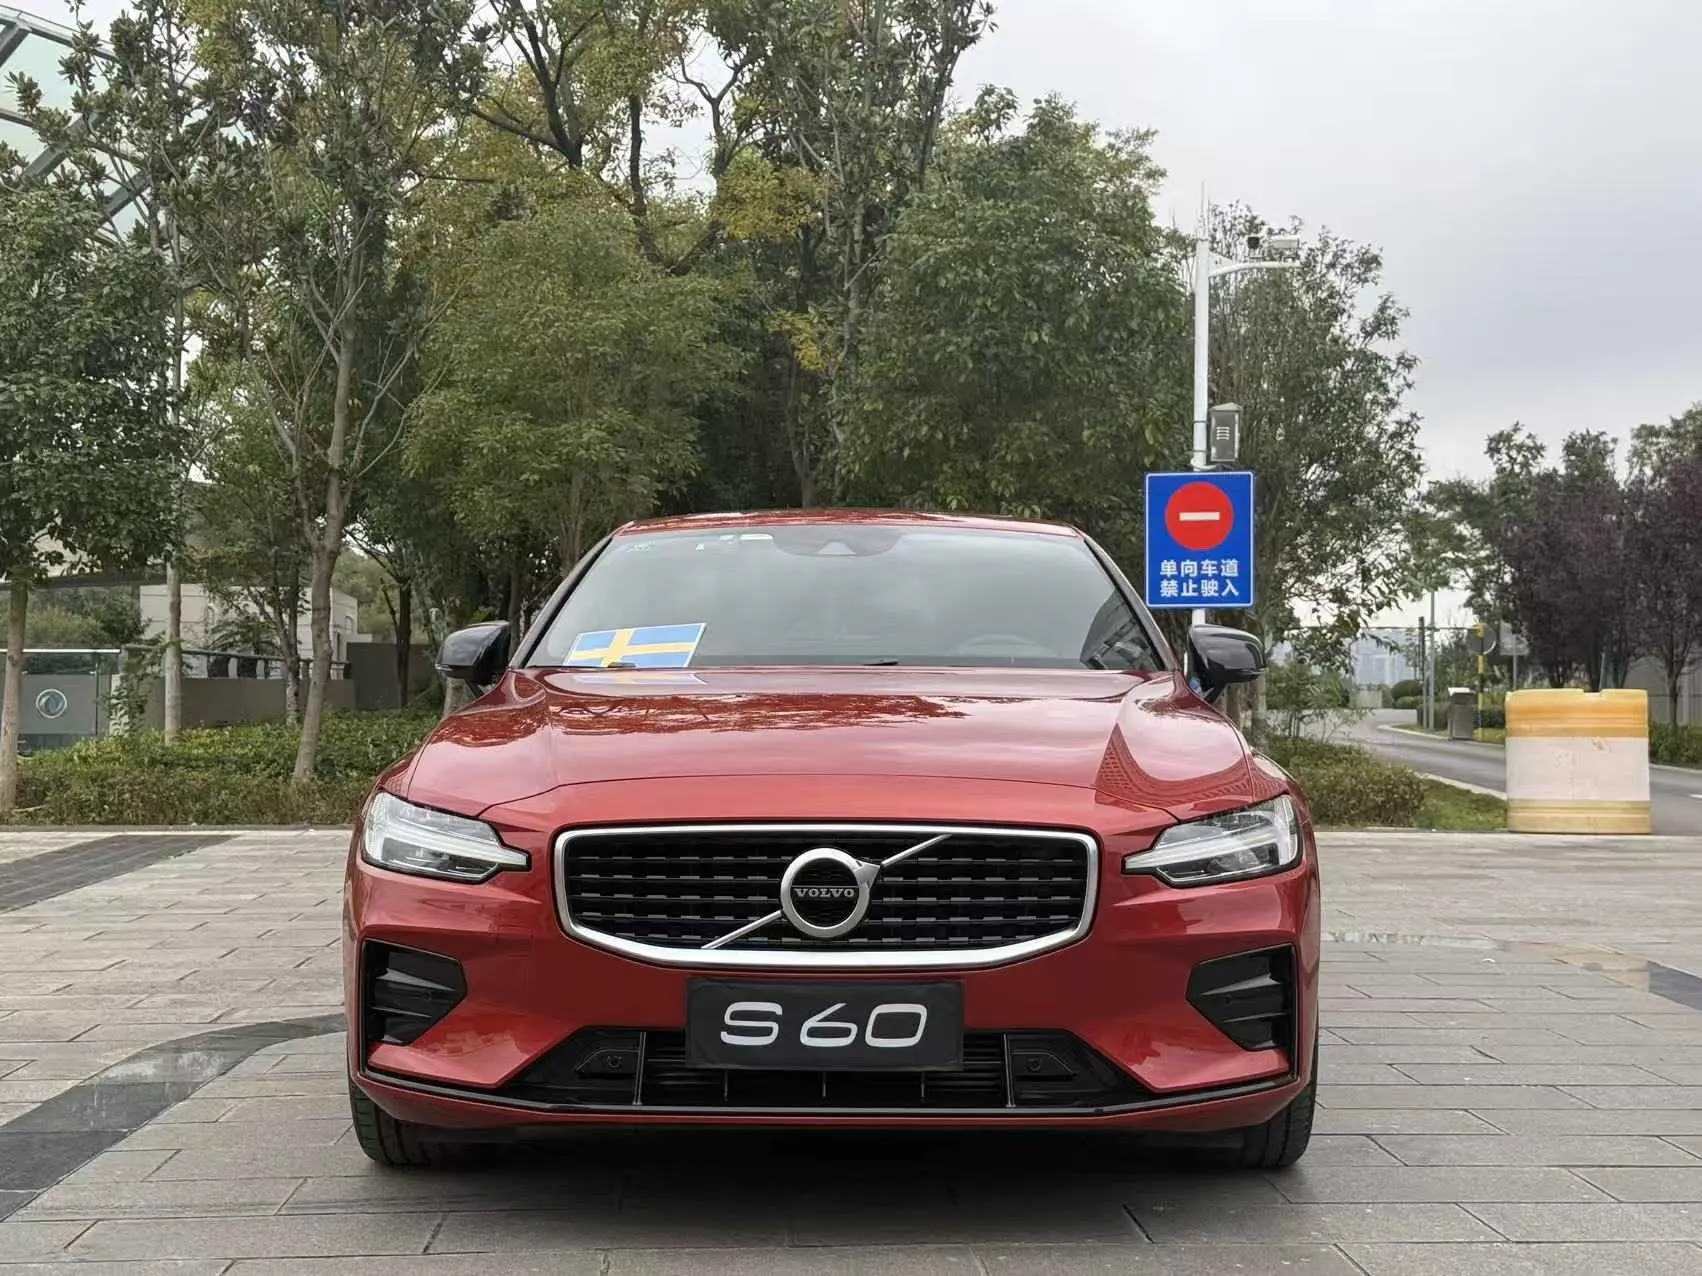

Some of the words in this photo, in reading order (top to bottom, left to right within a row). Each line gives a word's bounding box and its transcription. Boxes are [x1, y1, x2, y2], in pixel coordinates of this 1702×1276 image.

[1160, 559, 1239, 577] 单向车道
[1160, 579, 1239, 597] 禁止驶入
[793, 887, 855, 898] VOLVO
